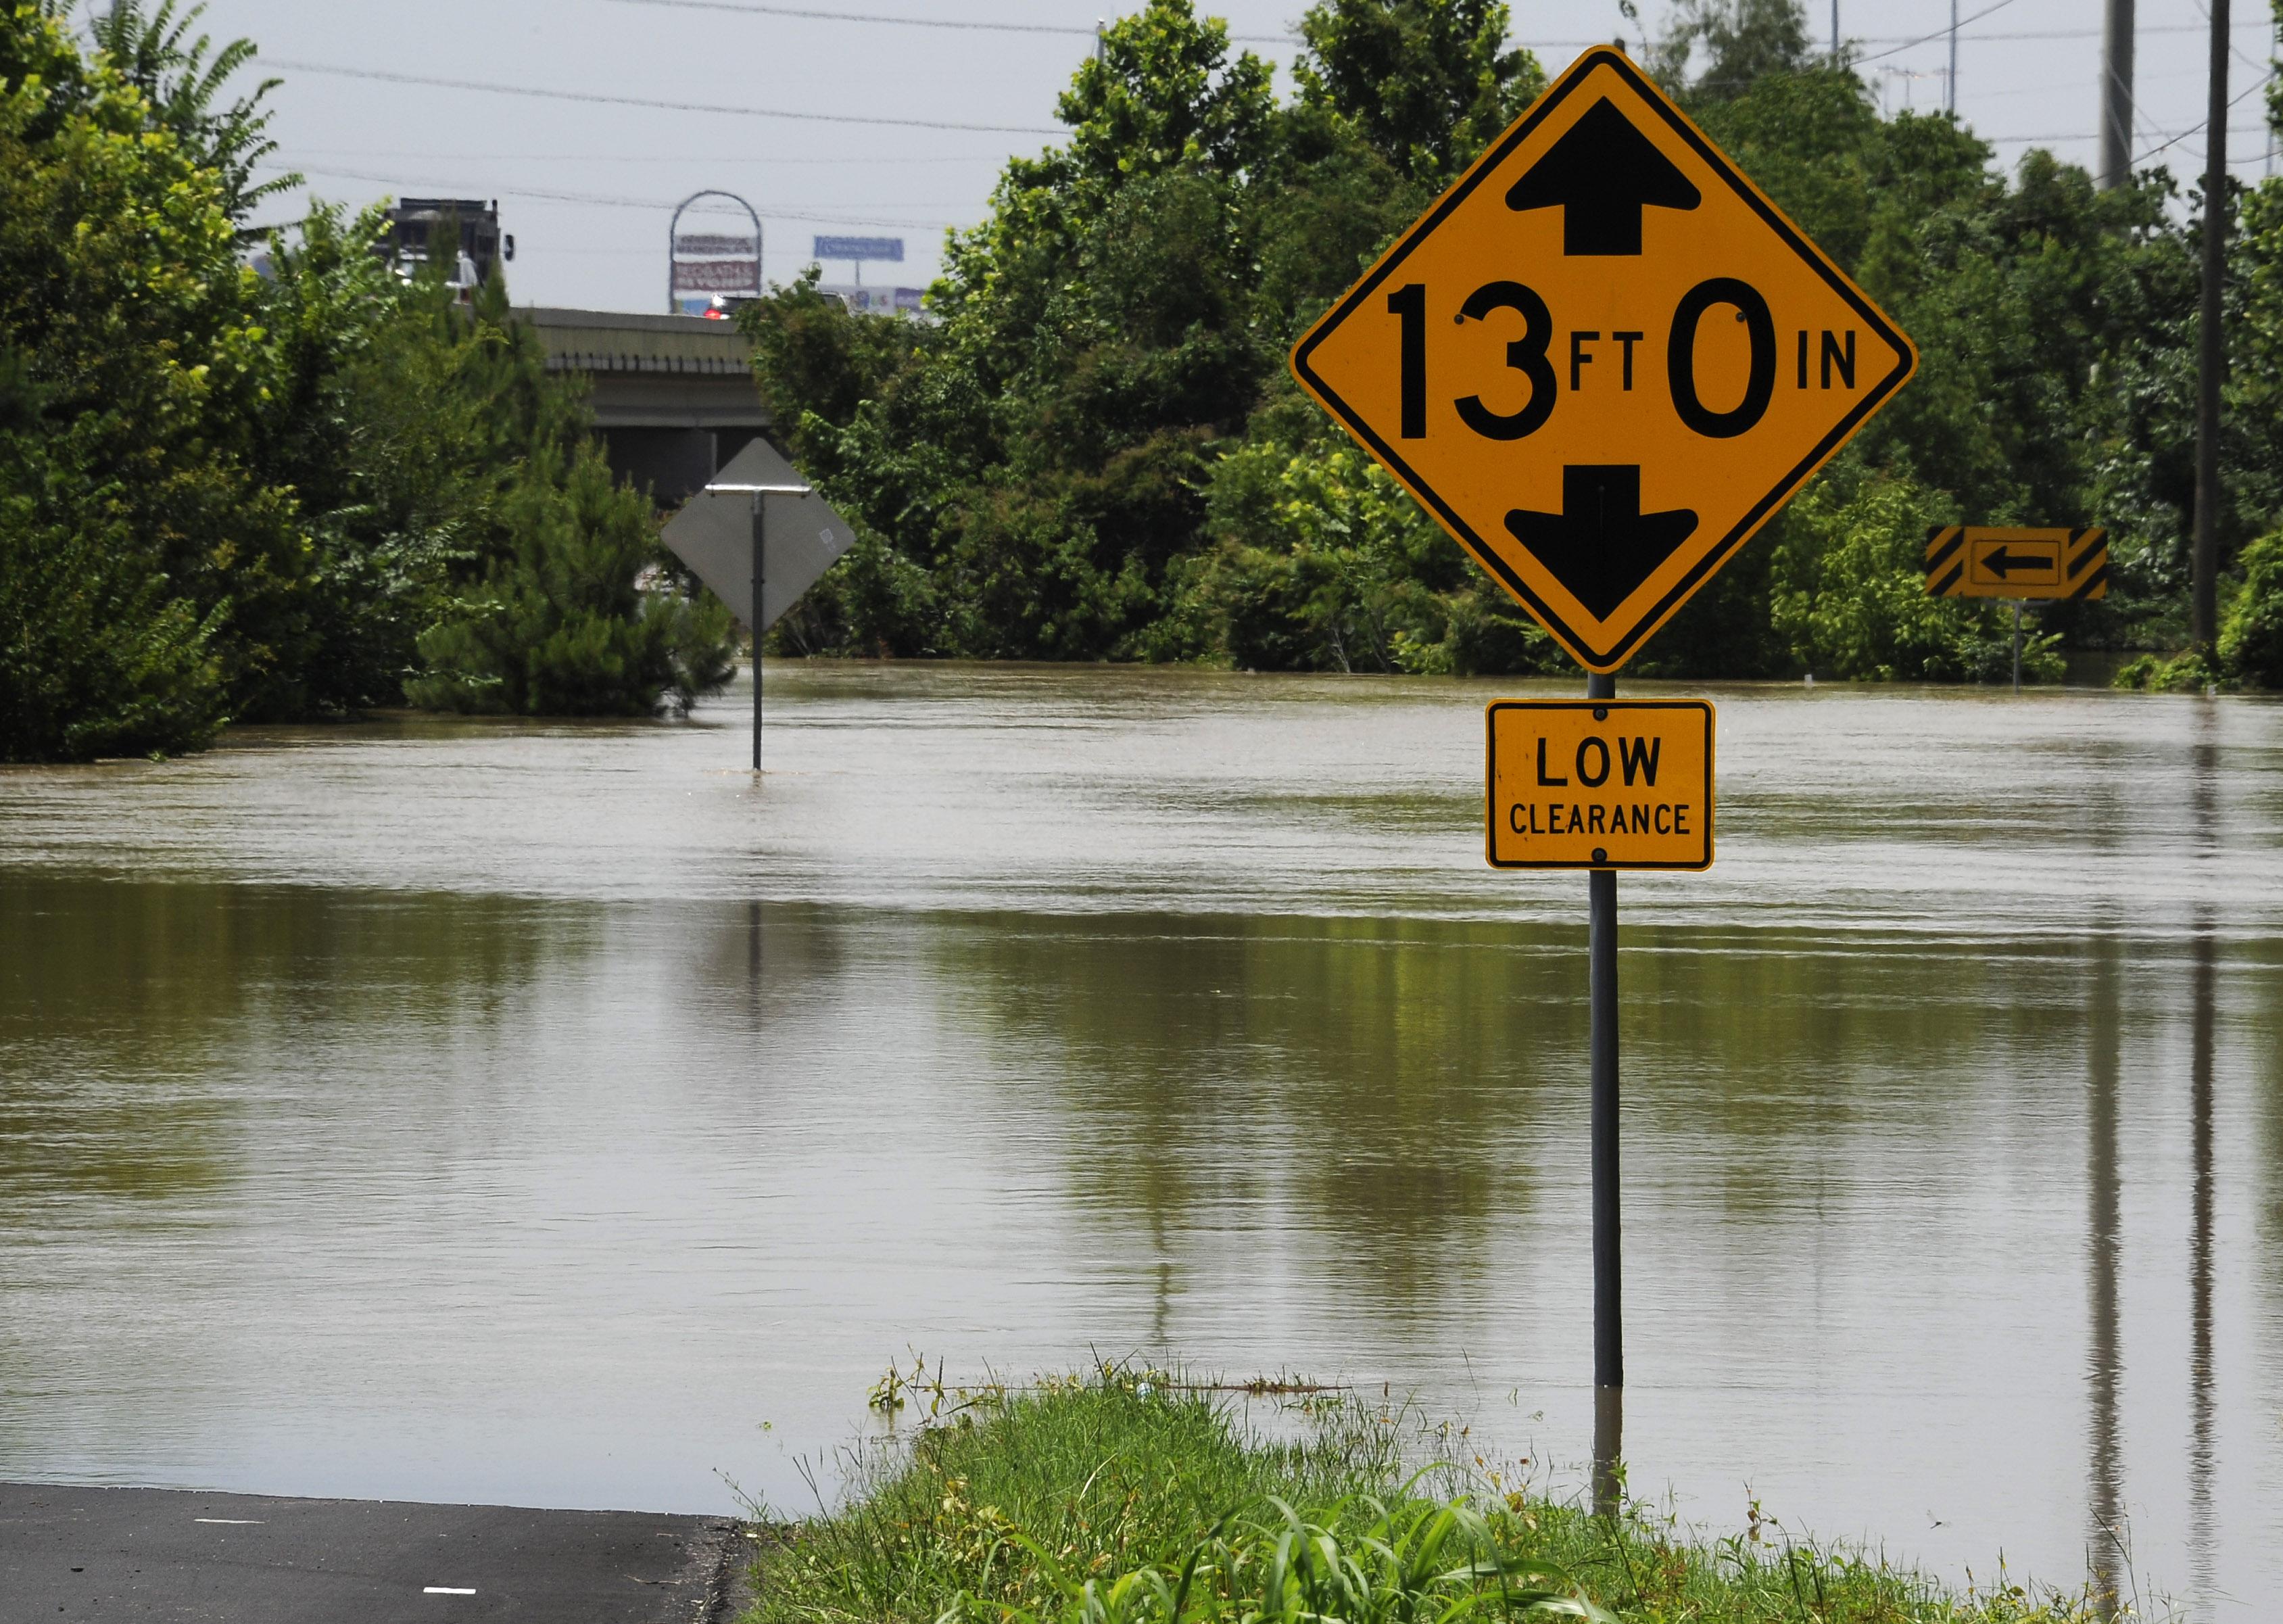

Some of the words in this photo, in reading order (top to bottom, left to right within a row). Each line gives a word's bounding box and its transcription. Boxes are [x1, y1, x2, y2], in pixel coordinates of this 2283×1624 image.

[1387, 280, 1558, 441] 13
[1570, 331, 1644, 391] FT
[1666, 277, 1777, 439] 0
[1797, 329, 1856, 390] IN
[1537, 736, 1661, 788] LOW
[1510, 803, 1691, 835] CLEARANCE
